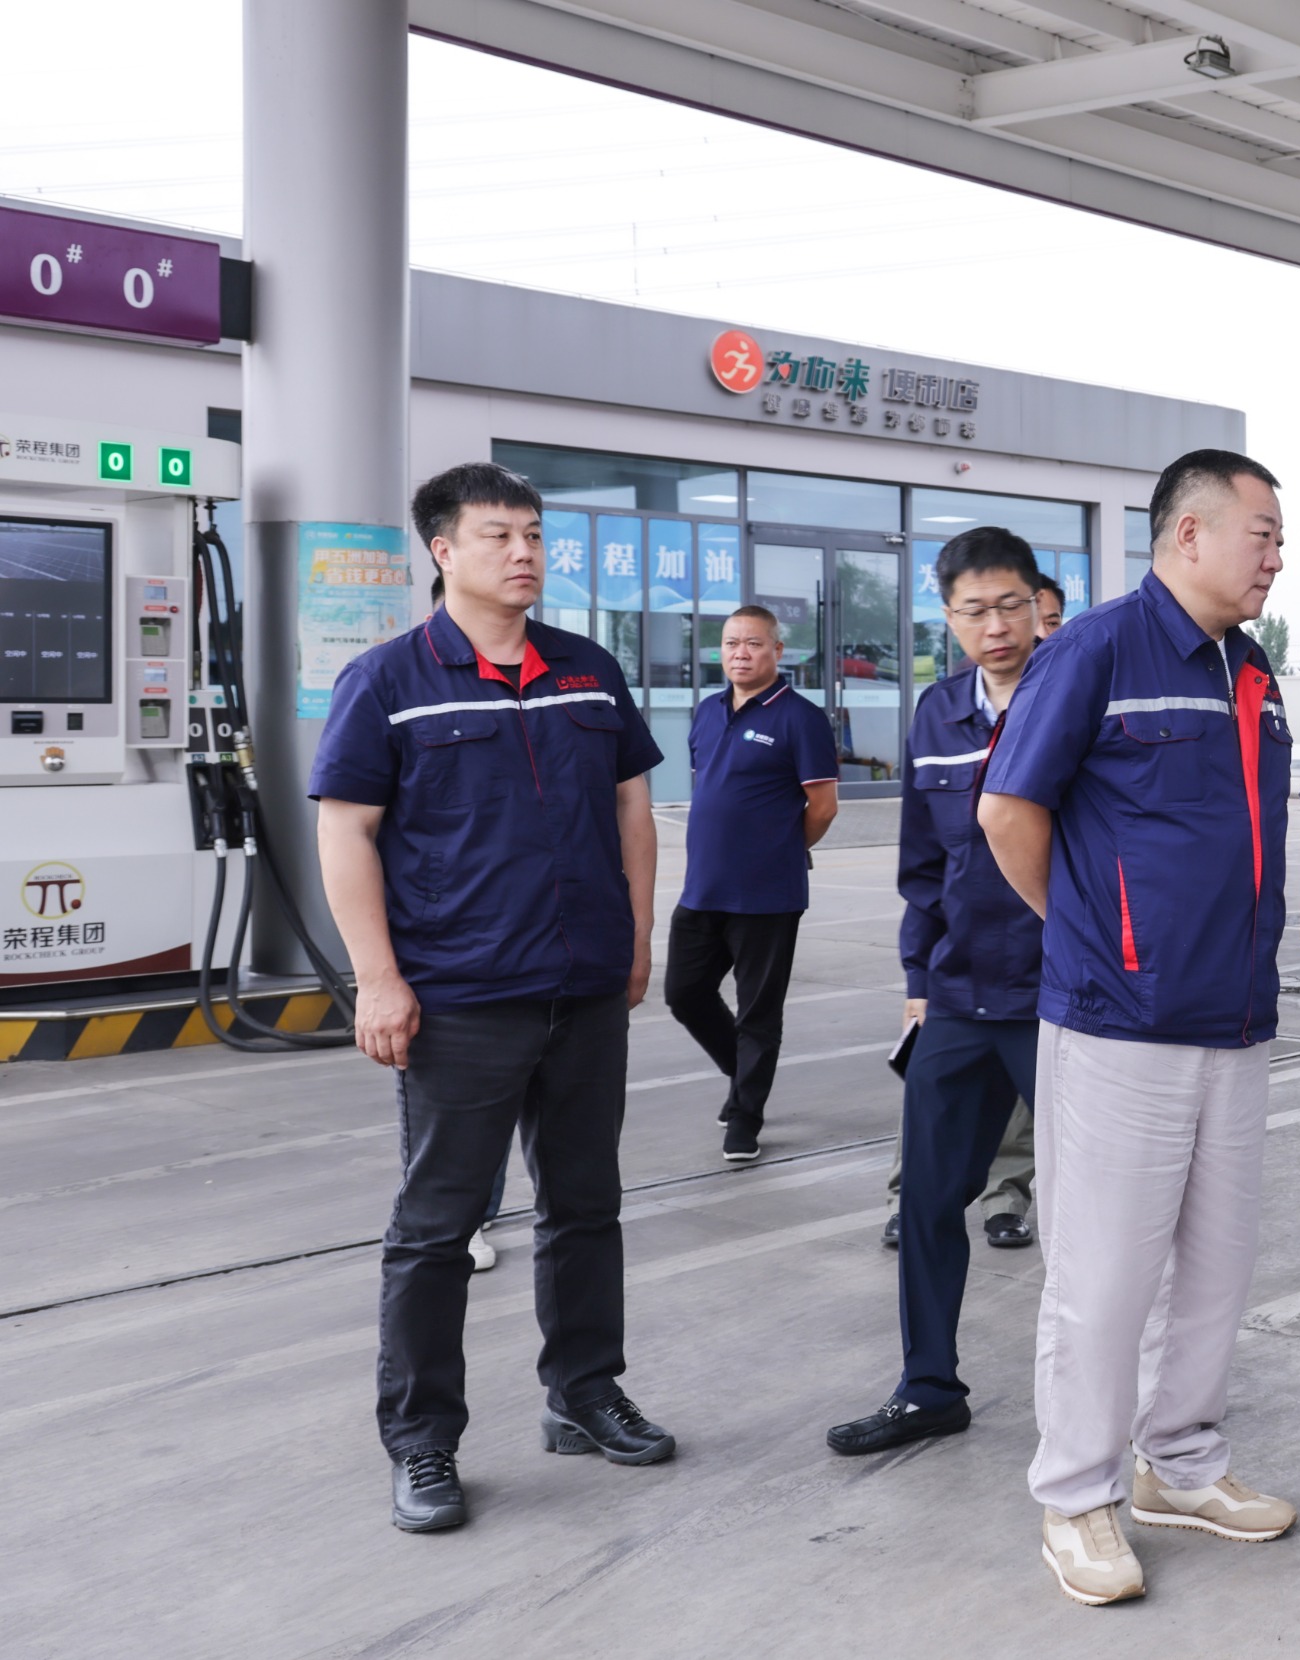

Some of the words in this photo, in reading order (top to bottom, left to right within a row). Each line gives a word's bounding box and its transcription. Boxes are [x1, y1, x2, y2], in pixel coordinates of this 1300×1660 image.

[30, 243, 83, 296] 0#
[123, 258, 173, 309] 0#
[766, 350, 870, 402] 为你来
[883, 368, 980, 412] 便利店
[16, 439, 80, 458] 荣程集团
[108, 452, 124, 471] 0
[168, 457, 184, 476] 0
[550, 538, 735, 583] 荣程加油
[1064, 574, 1085, 602] 油
[217, 723, 232, 737] 0
[3, 922, 105, 950] 荣程集团
